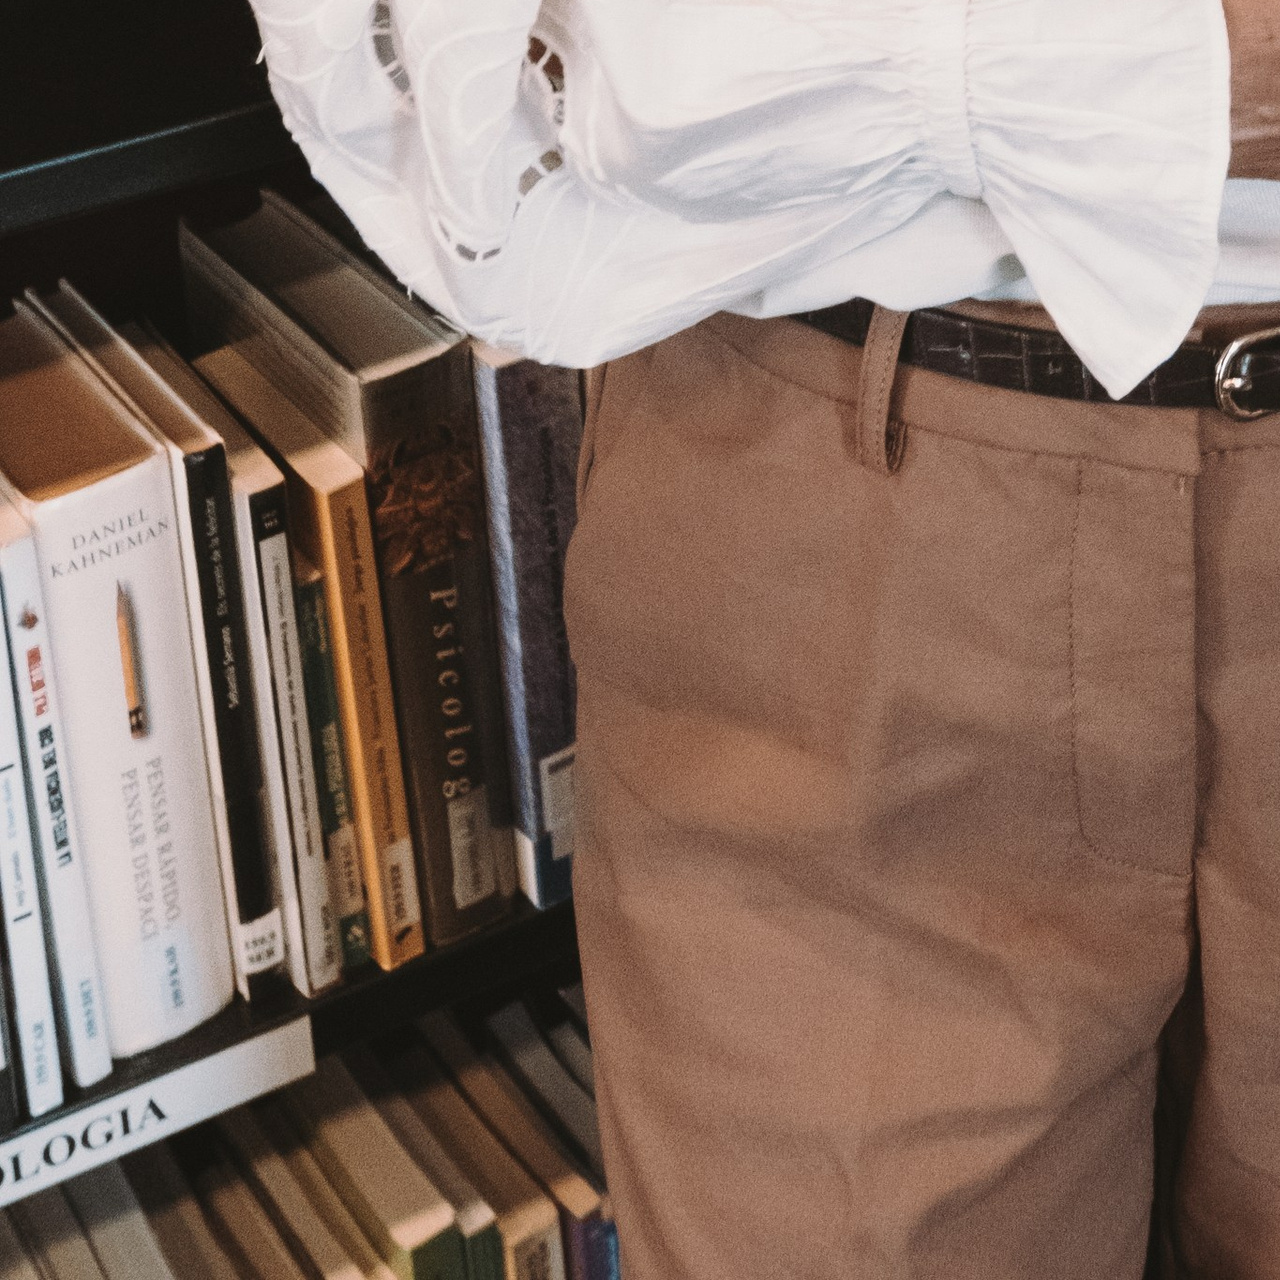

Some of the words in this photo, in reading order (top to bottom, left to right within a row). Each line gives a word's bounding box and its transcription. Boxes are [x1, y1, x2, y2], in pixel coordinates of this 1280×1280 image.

[50, 519, 171, 579] KAHNEMAN
[71, 506, 151, 551] DANIEL
[121, 767, 146, 851] PENSAR
[147, 756, 169, 843] PENSAR
[0, 1096, 168, 1189] LOGIA
